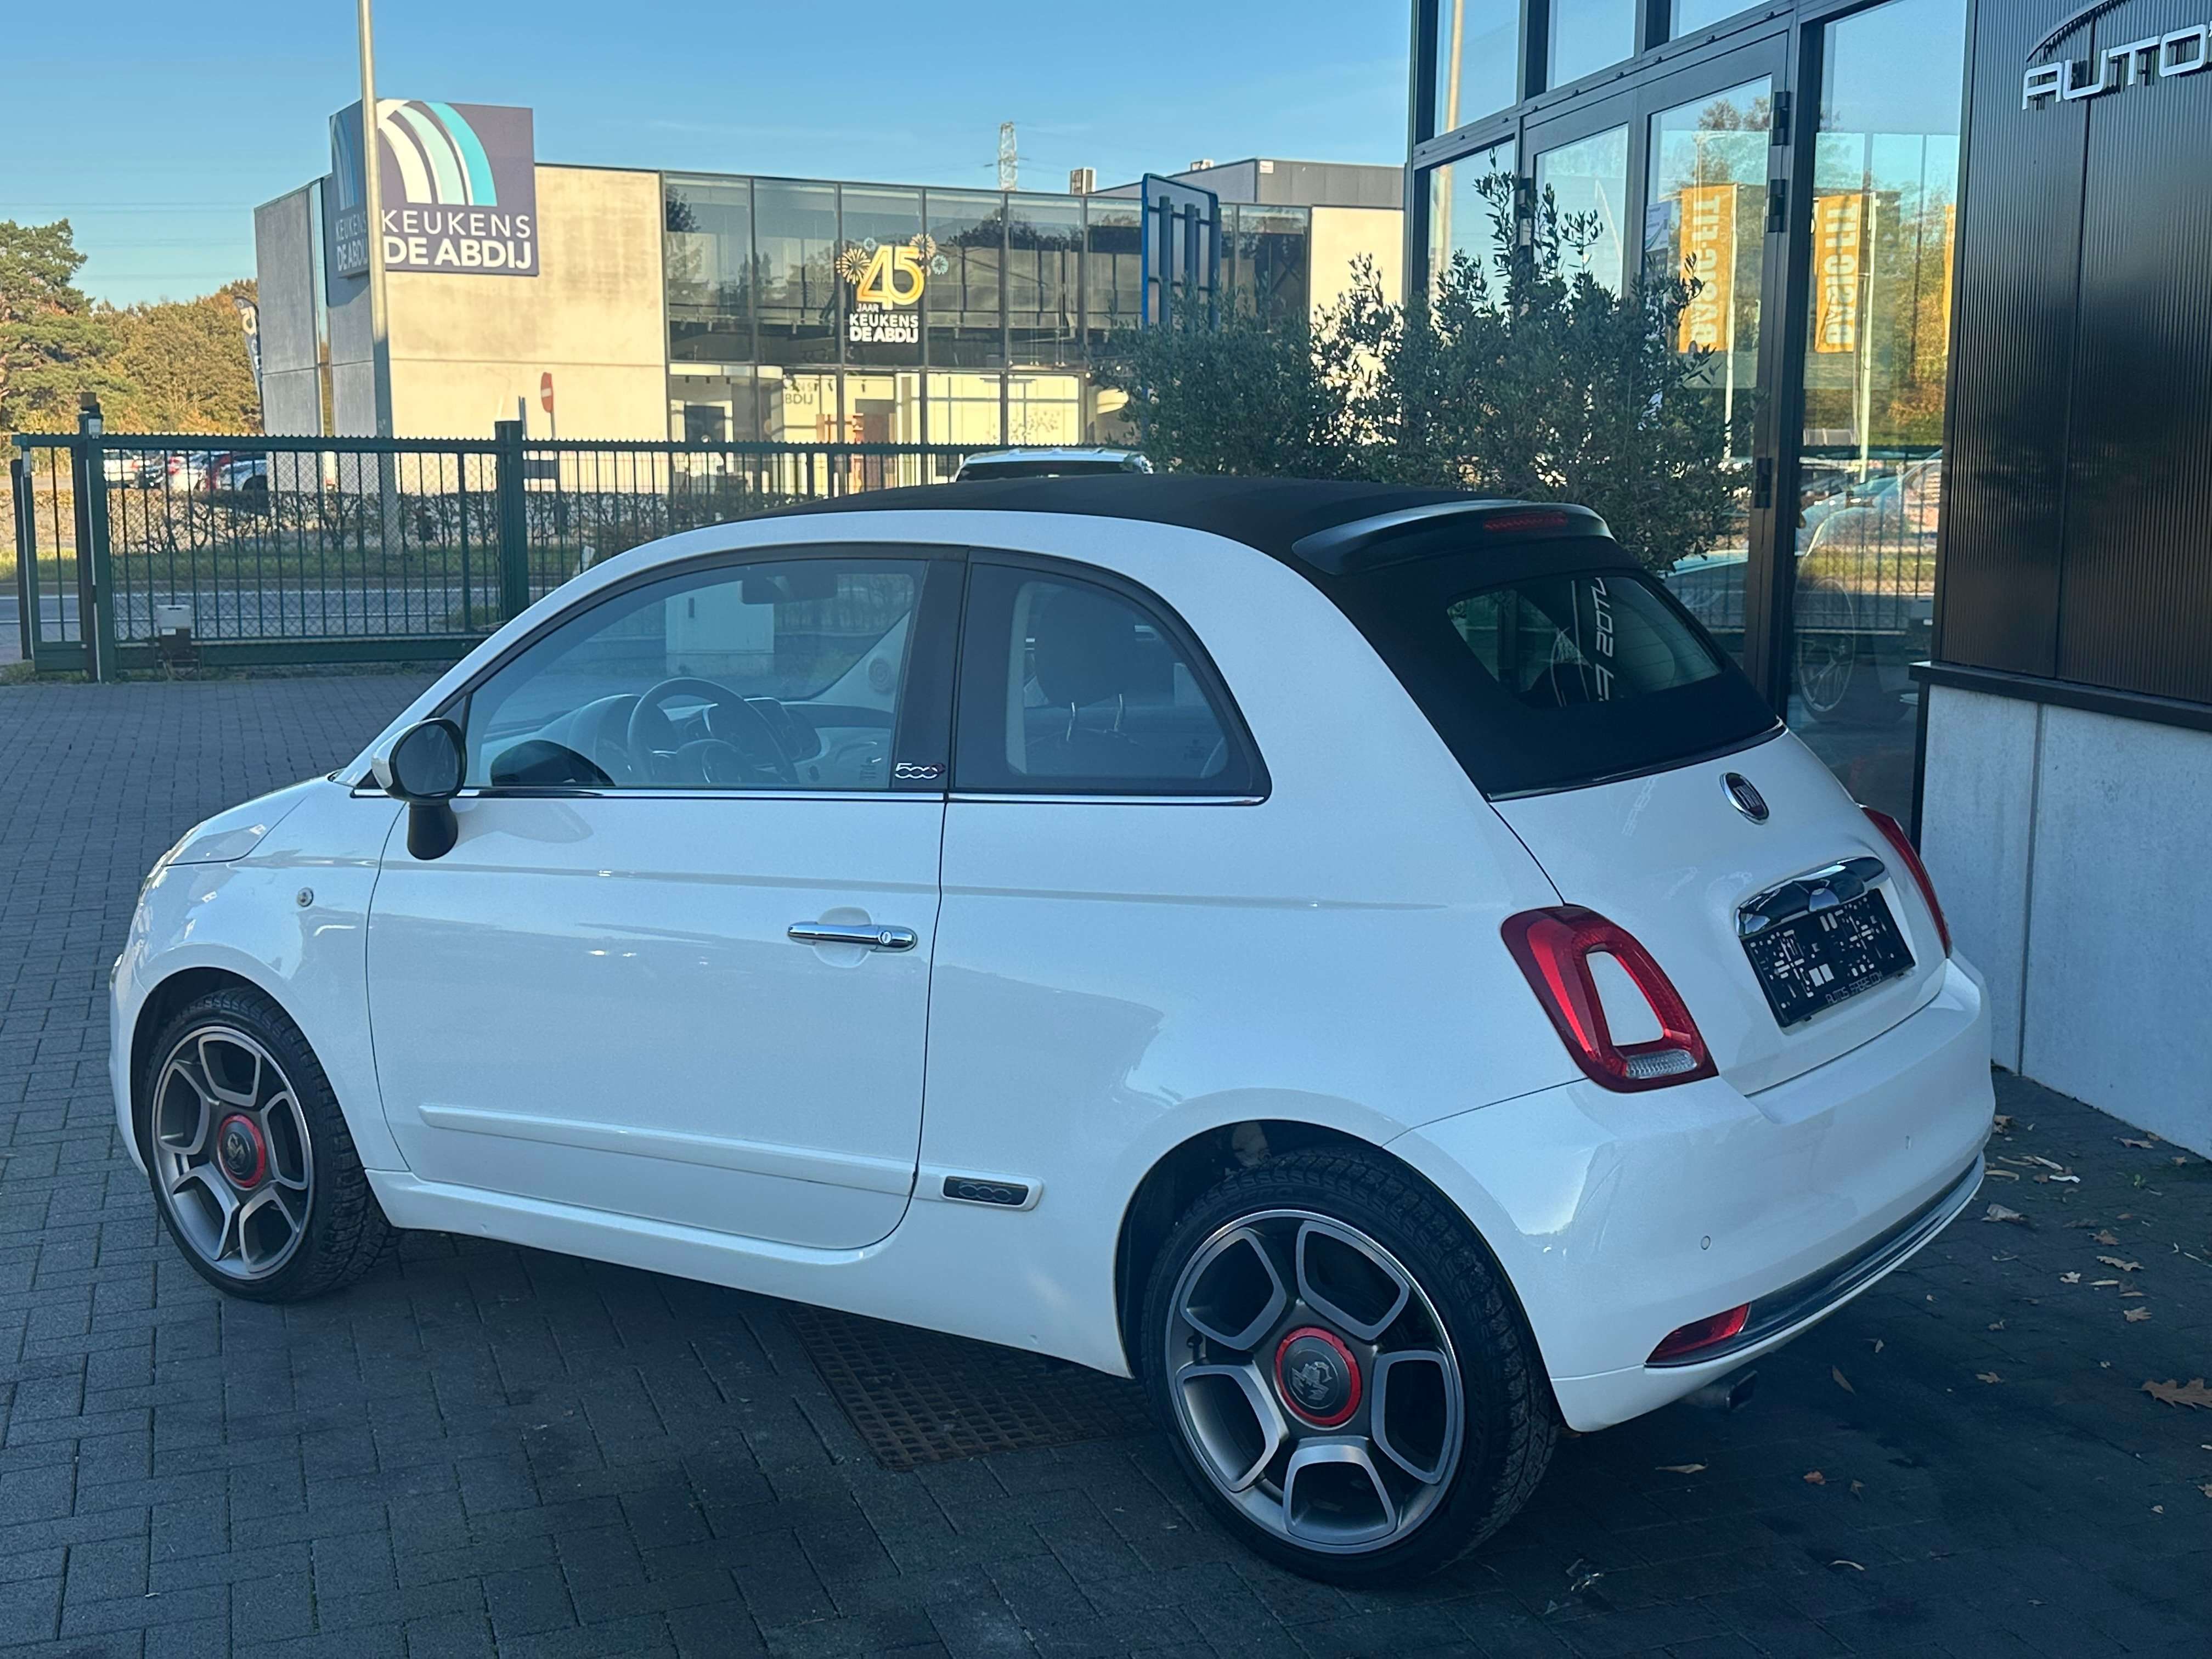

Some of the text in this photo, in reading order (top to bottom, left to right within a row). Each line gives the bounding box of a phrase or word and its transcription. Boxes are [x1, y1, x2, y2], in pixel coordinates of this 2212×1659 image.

[382, 210, 531, 239] KEUKENS
[337, 244, 348, 271] DE
[384, 235, 532, 270] DE ABDIJ
[856, 245, 926, 311] 45
[856, 303, 879, 312] JAAR
[849, 313, 919, 328] KEUKENS
[849, 326, 919, 343] DE ABDIJ
[785, 393, 813, 405] BDIJ
